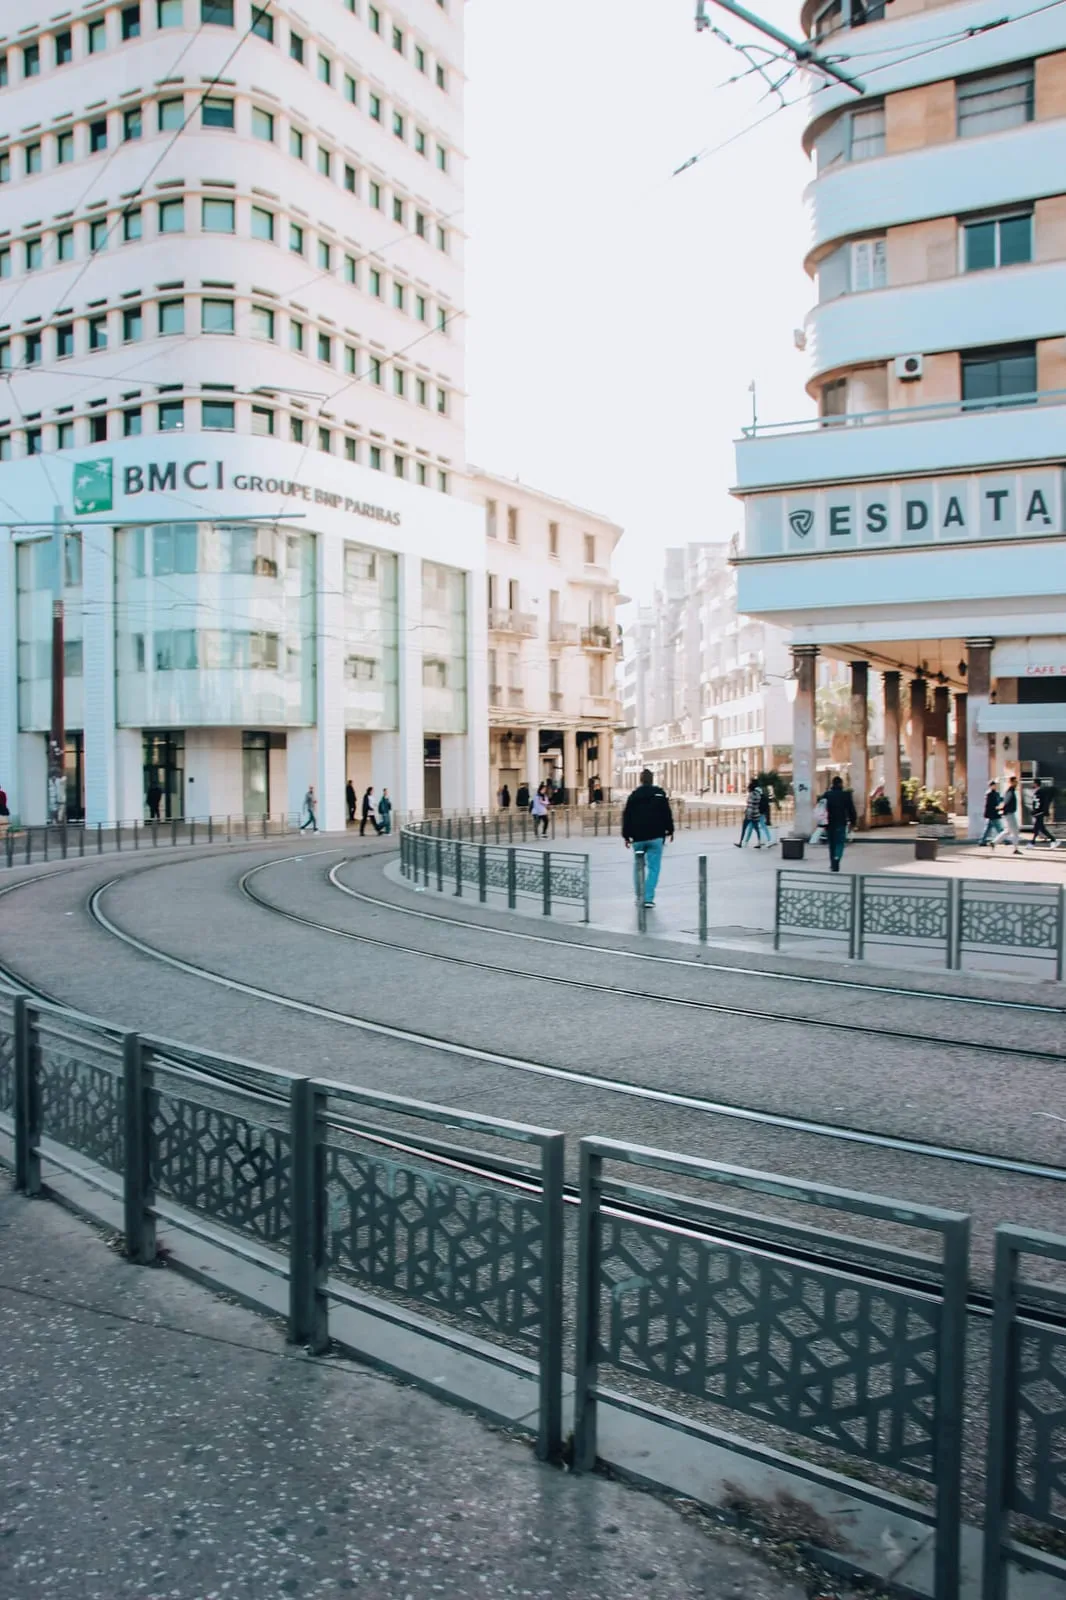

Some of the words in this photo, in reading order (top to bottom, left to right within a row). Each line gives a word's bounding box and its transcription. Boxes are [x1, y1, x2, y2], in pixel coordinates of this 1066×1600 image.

[123, 460, 224, 495] BMCI
[233, 475, 312, 500] GROUPE
[314, 487, 343, 509] BNP
[345, 497, 401, 526] PARIBAS
[829, 489, 1052, 536] ESDATA
